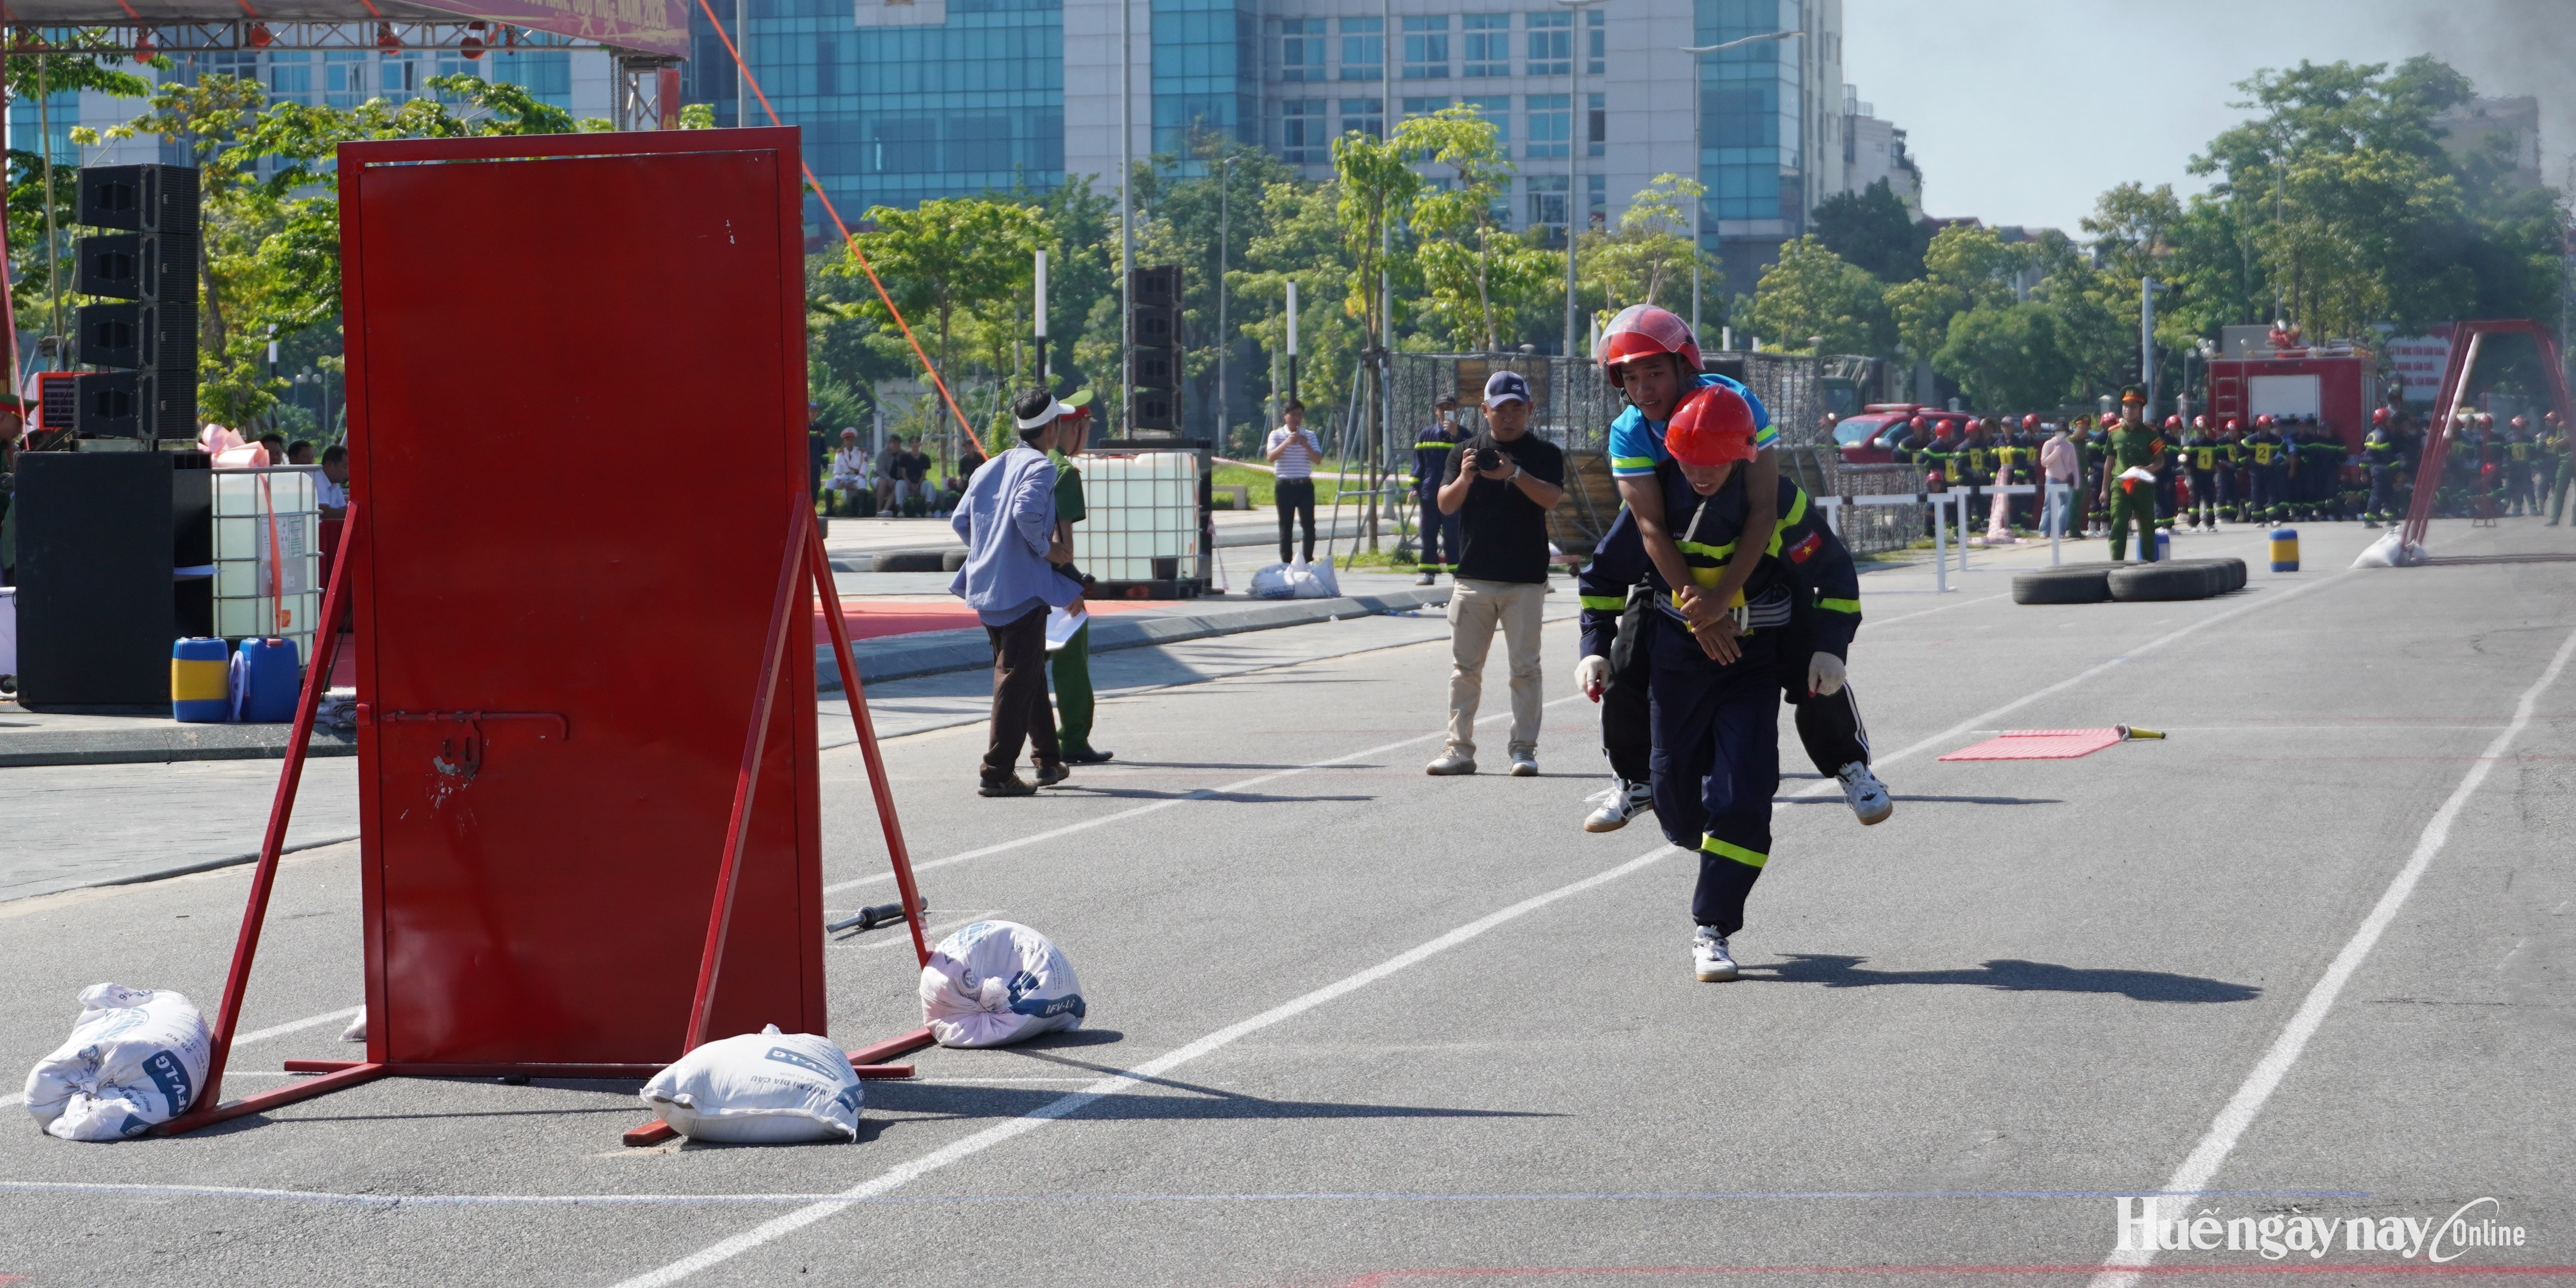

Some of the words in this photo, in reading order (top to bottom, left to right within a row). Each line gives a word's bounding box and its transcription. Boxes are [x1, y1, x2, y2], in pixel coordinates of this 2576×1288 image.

[1973, 453, 1980, 465] 2
[2258, 447, 2266, 459] 2
[2201, 454, 2207, 465] 1
[772, 1049, 835, 1079] IFV-LG
[779, 1071, 804, 1079] FLOUR
[155, 1055, 187, 1114] IFV-LG
